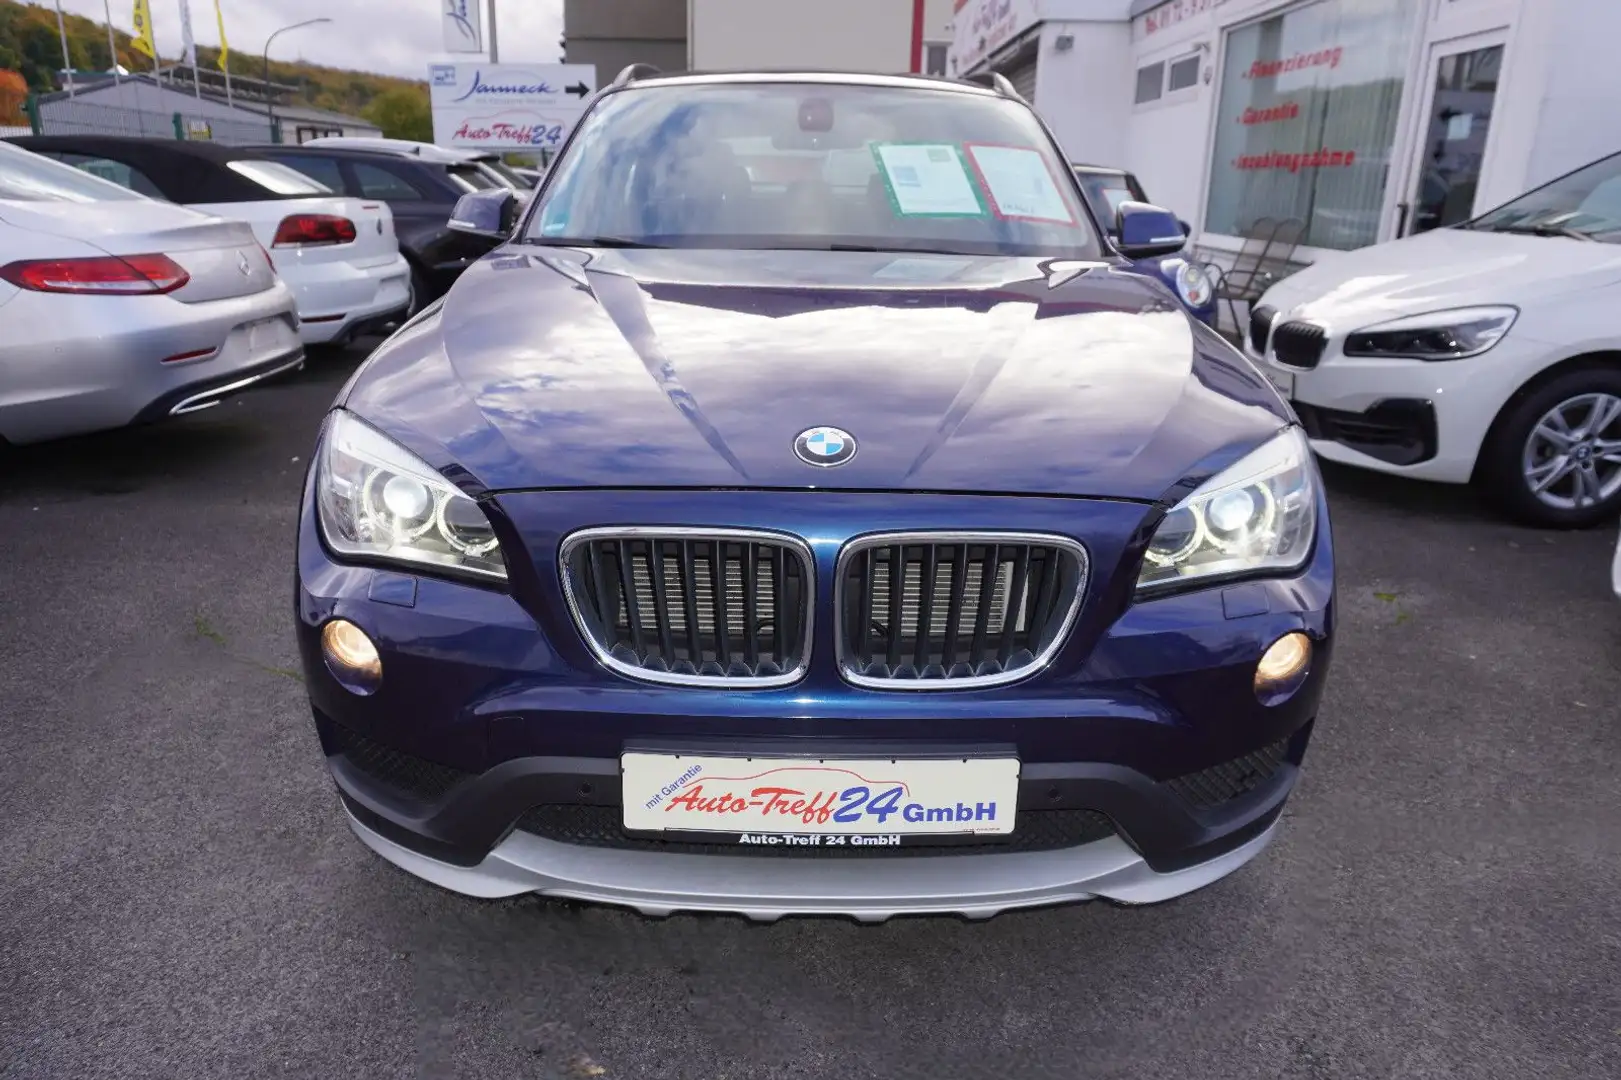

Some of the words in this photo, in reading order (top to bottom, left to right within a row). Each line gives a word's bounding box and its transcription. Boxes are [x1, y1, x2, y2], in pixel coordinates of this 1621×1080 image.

[1248, 46, 1343, 79] Finanzierung
[1242, 101, 1299, 125] Garantie
[645, 794, 661, 810] mit
[661, 764, 703, 796] Garantie
[903, 802, 997, 823] GmbH
[739, 833, 821, 846] Auto-Treff
[825, 835, 846, 846] 24
[850, 834, 901, 846] GmbH
